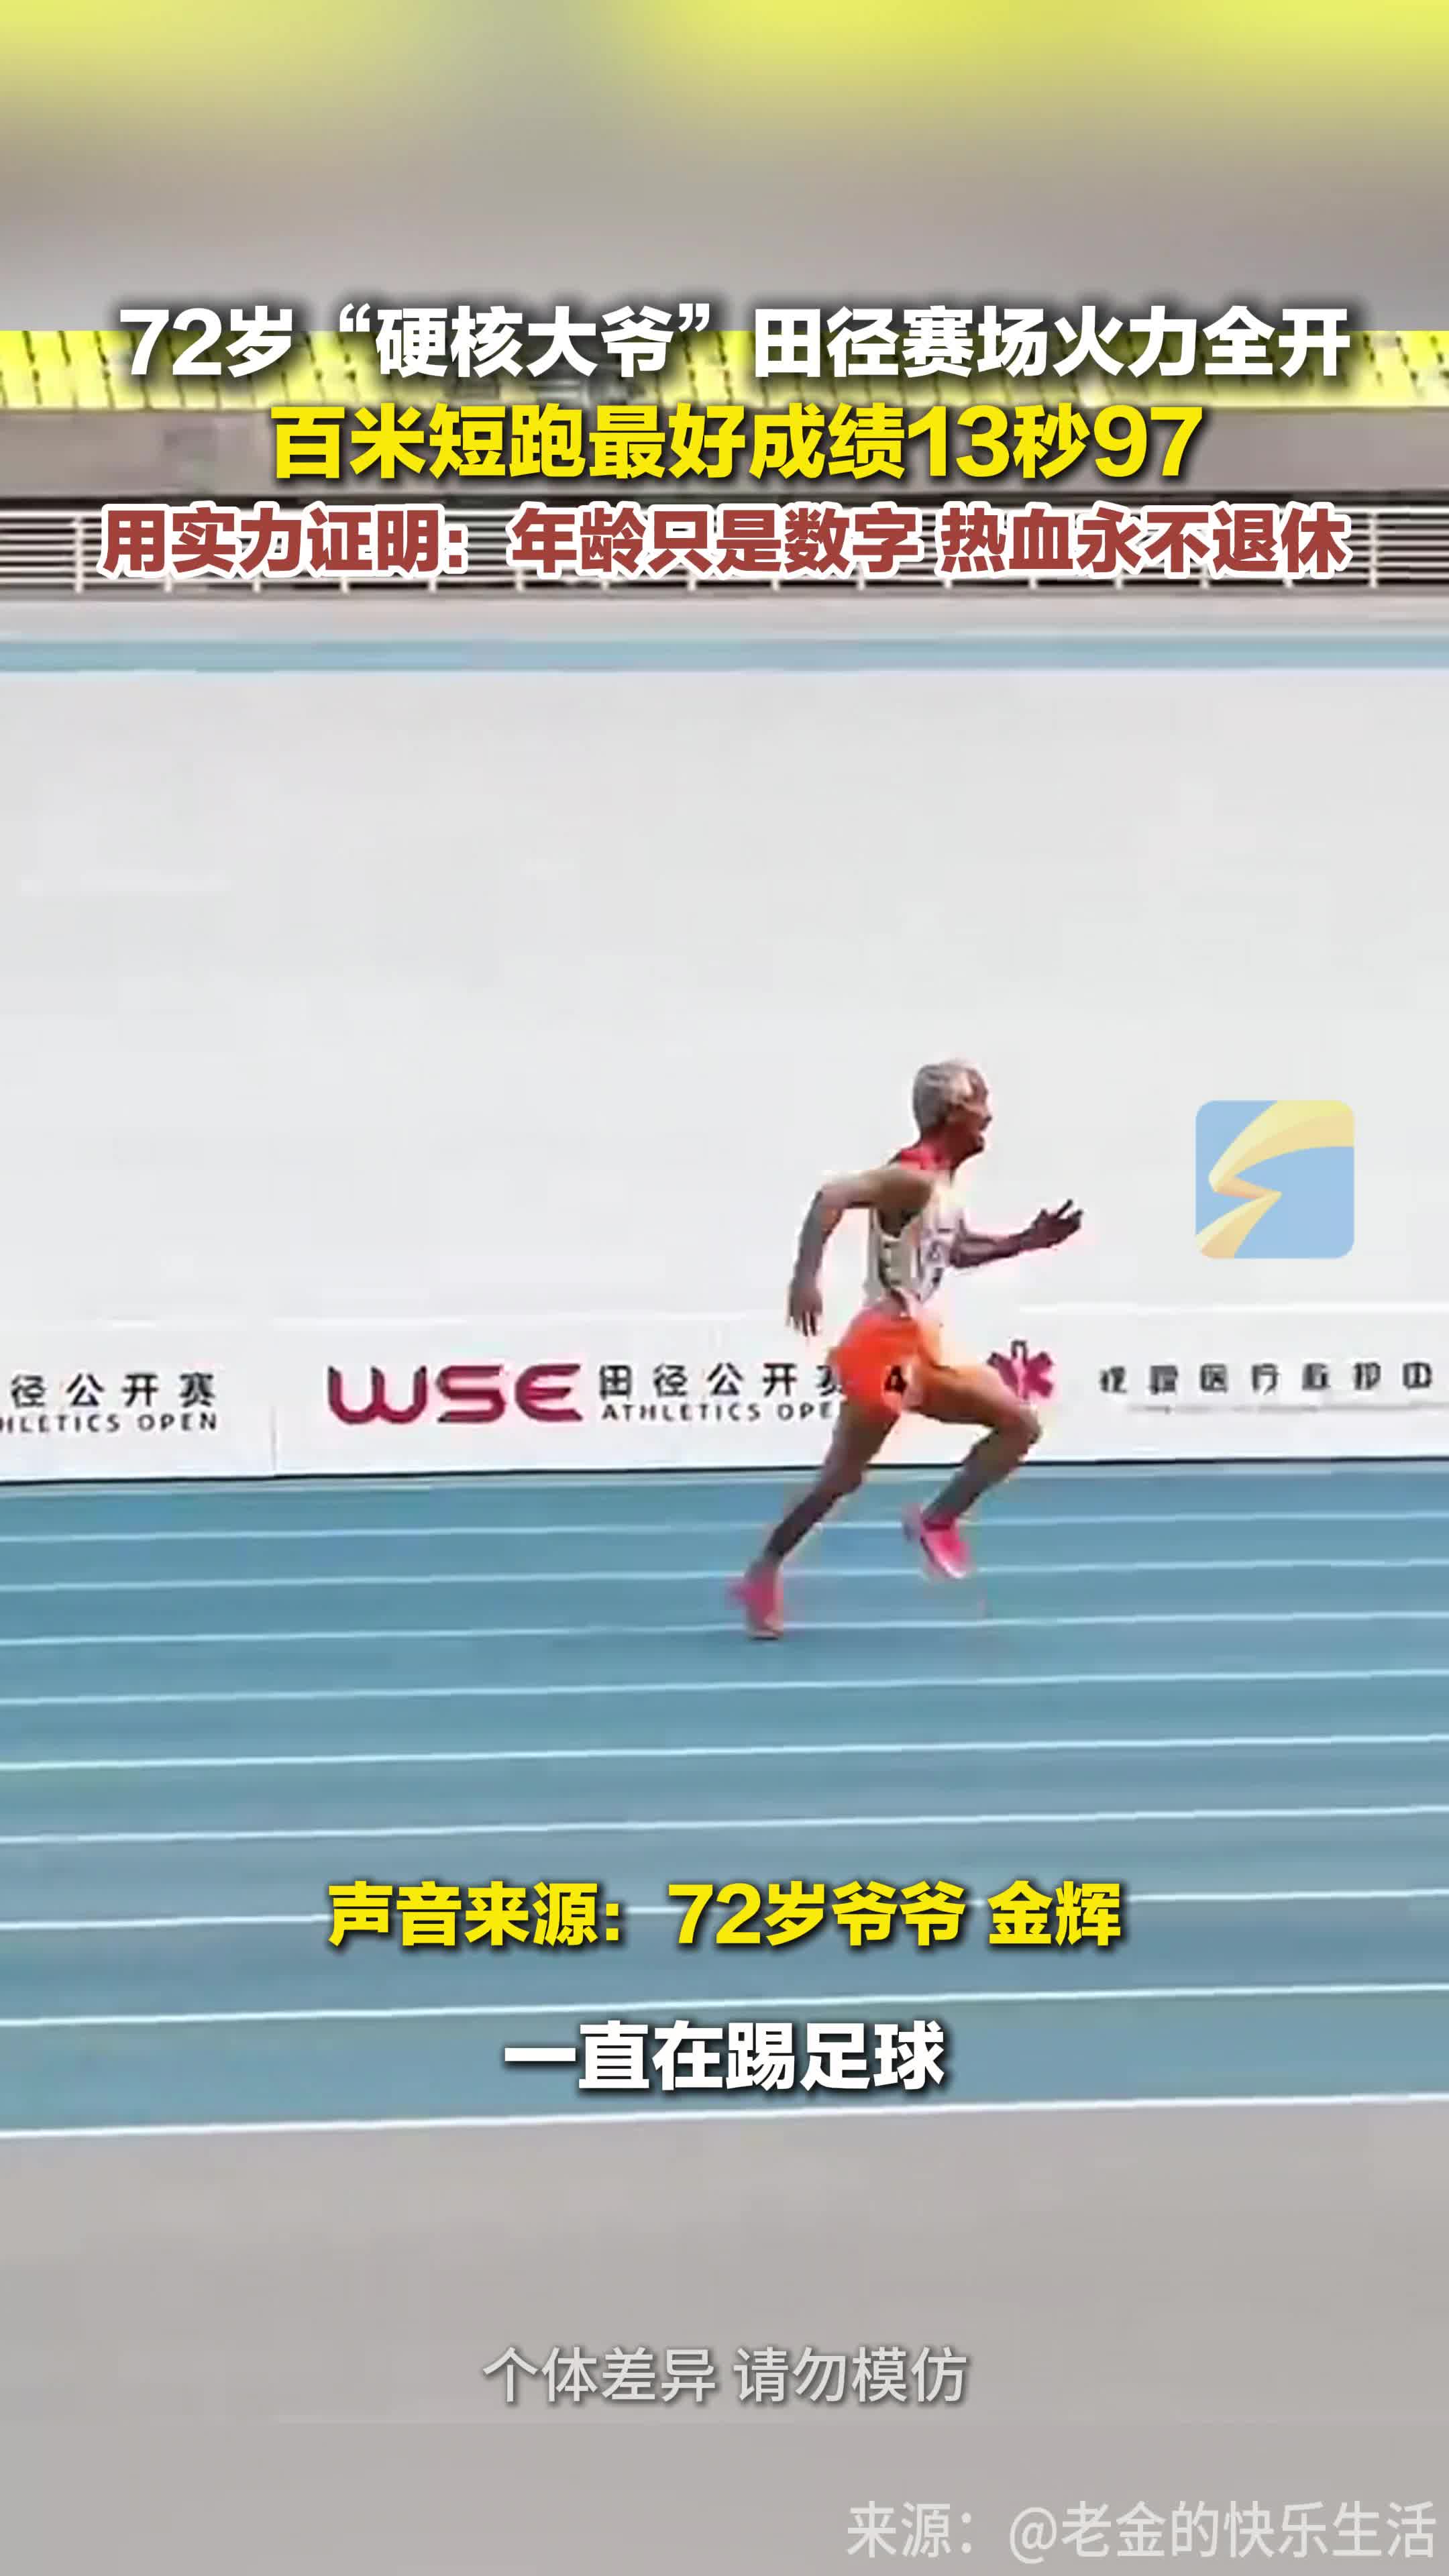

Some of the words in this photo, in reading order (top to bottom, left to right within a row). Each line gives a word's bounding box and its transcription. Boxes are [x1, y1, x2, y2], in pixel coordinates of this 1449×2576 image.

[327, 1363, 583, 1425] WSE
[602, 1402, 761, 1421] ATHLETICS
[137, 1412, 217, 1432] OPEN
